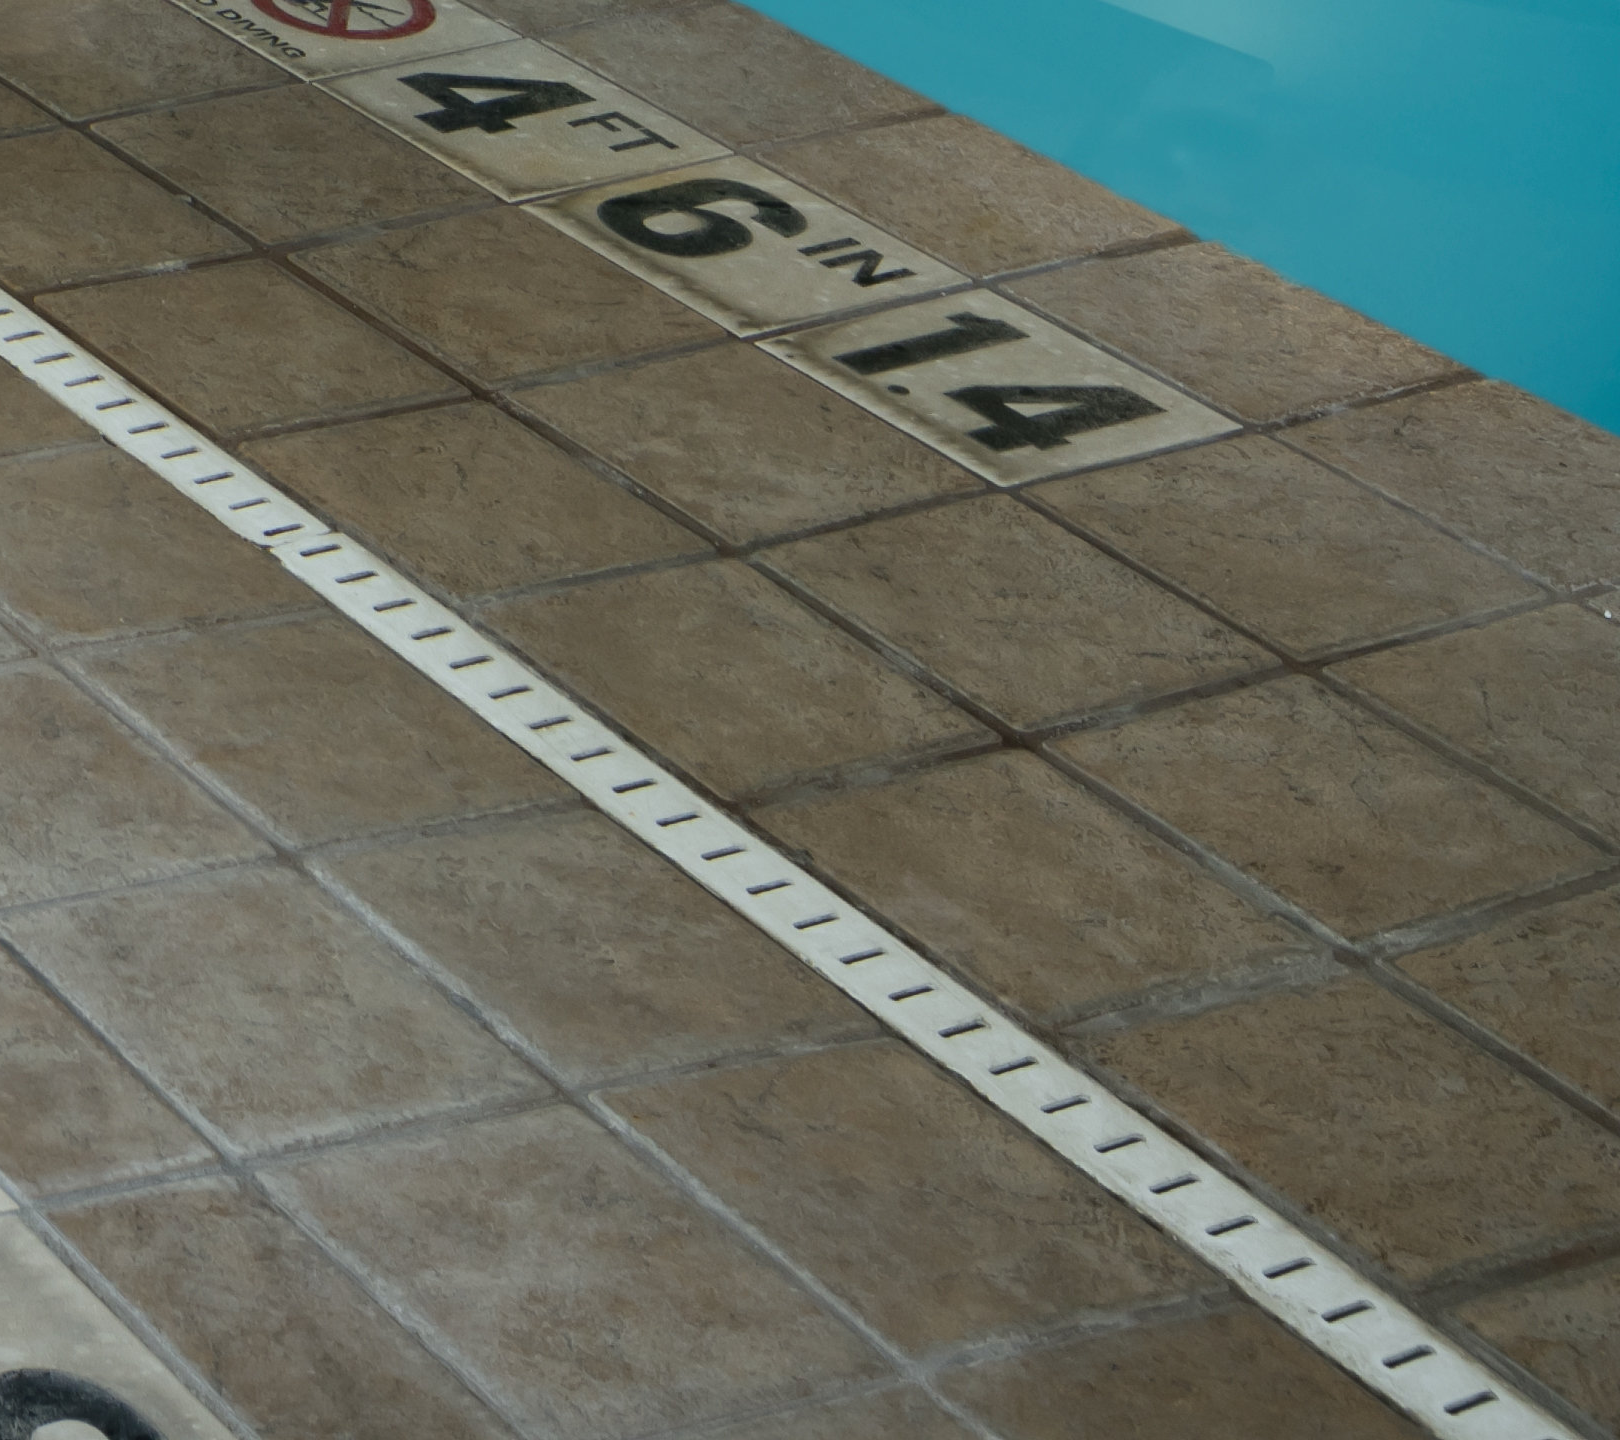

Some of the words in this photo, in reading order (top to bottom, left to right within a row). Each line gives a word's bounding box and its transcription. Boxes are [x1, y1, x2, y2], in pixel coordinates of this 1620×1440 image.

[215, 7, 308, 61] DIVING
[396, 71, 597, 134] 4
[569, 110, 680, 155] FT
[596, 178, 808, 258] 6
[797, 236, 916, 289] IN
[832, 312, 1165, 452] 1.4
